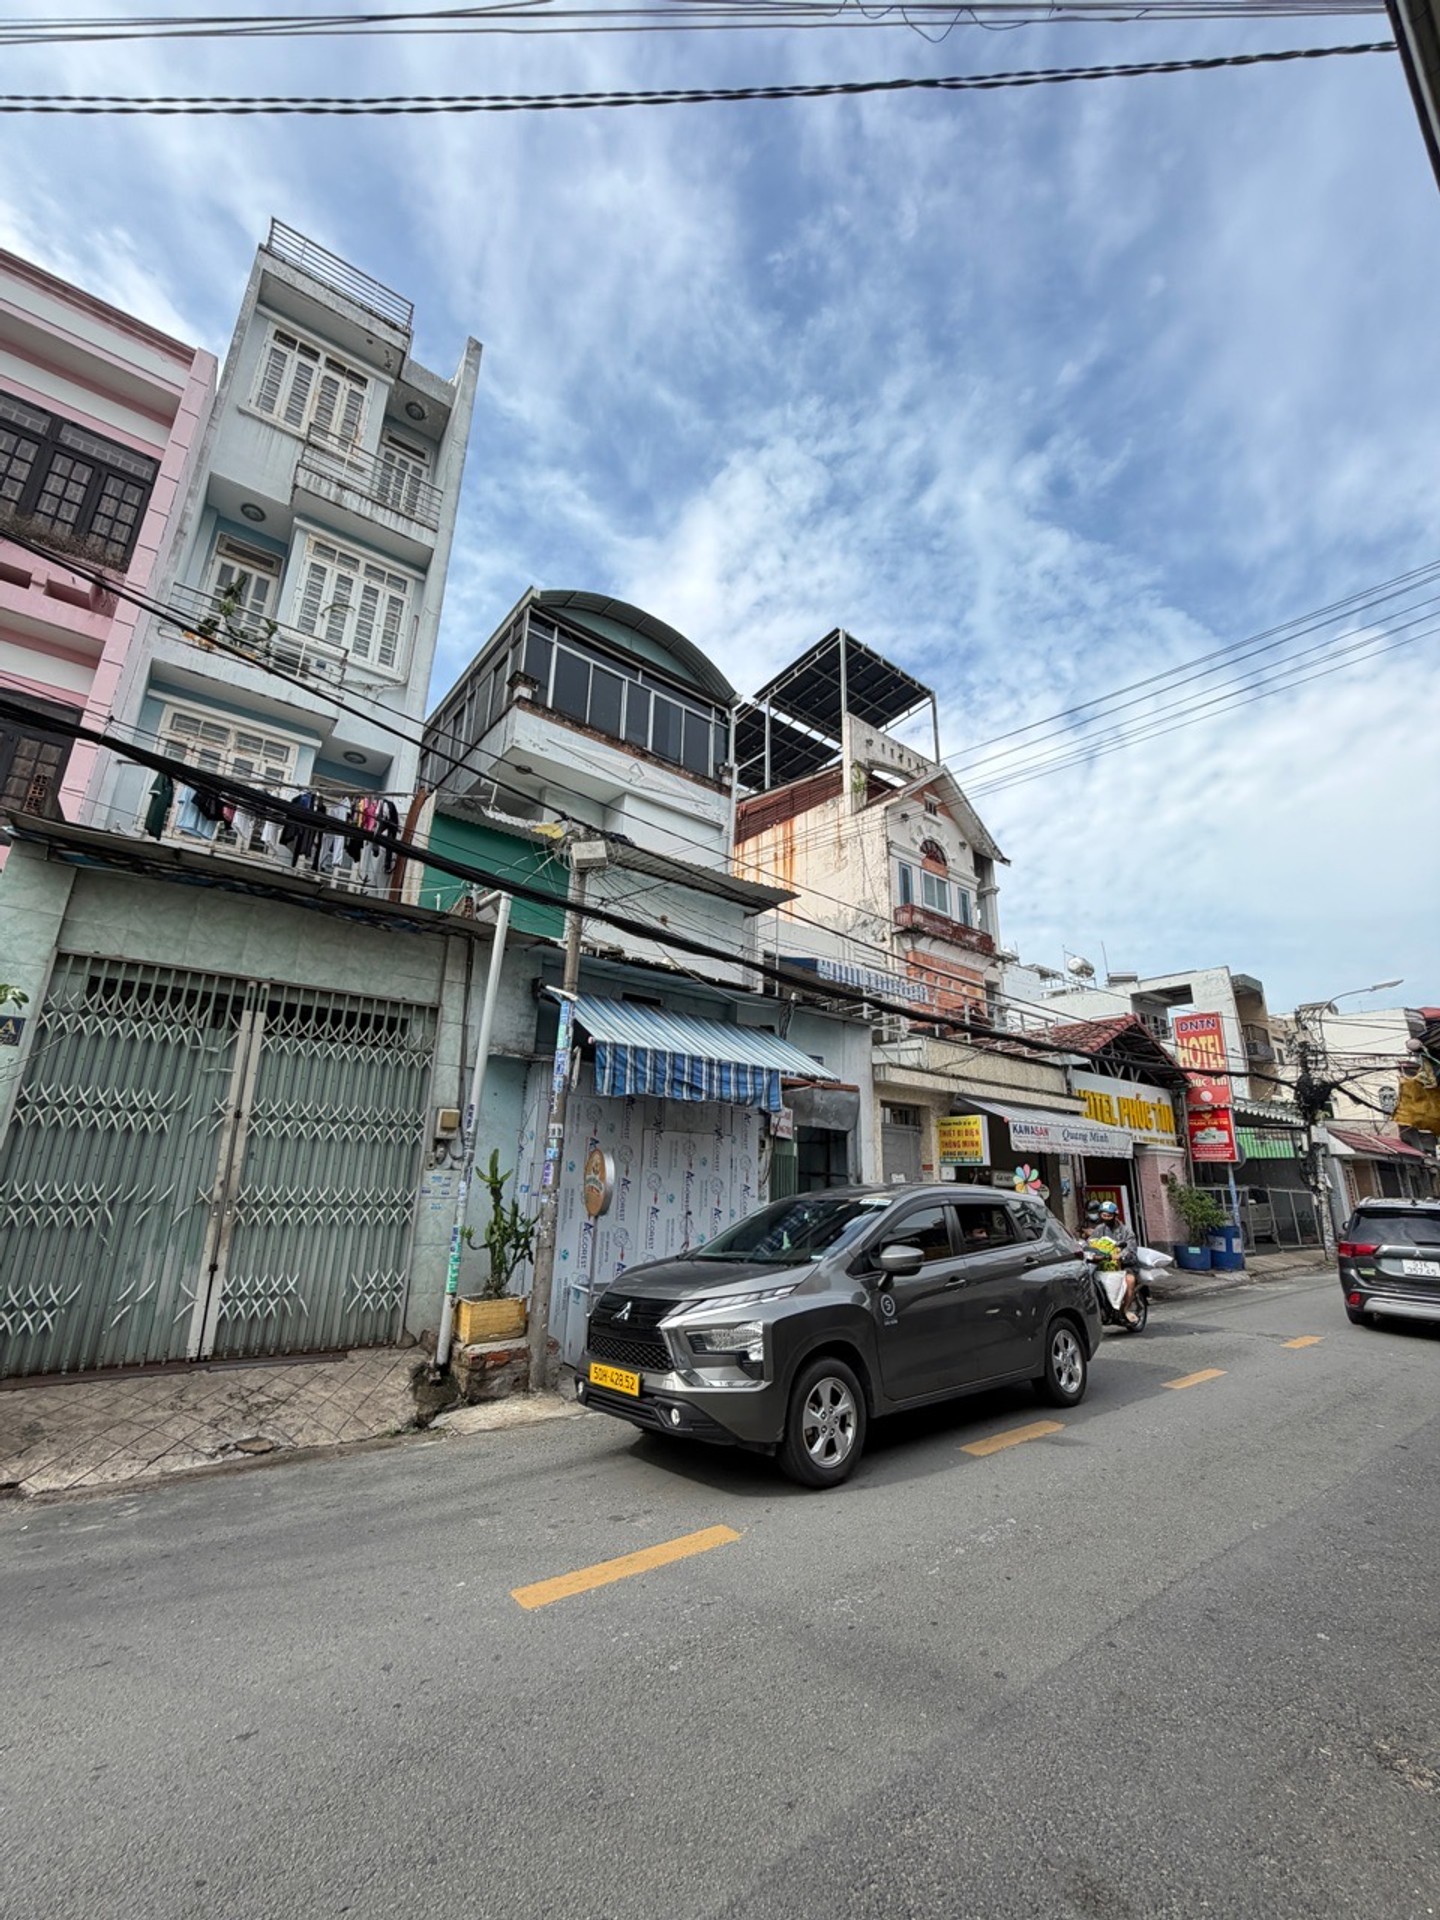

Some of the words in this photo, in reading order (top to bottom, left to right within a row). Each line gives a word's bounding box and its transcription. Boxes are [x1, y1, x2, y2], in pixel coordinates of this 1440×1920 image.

[1180, 1016, 1215, 1032] DNTN
[1177, 1035, 1226, 1068] HOTEL
[1117, 1093, 1153, 1131] PHÚC
[1012, 1123, 1050, 1137] KAWASAN
[1061, 1128, 1088, 1143] Quang
[1089, 1131, 1110, 1143] Minh
